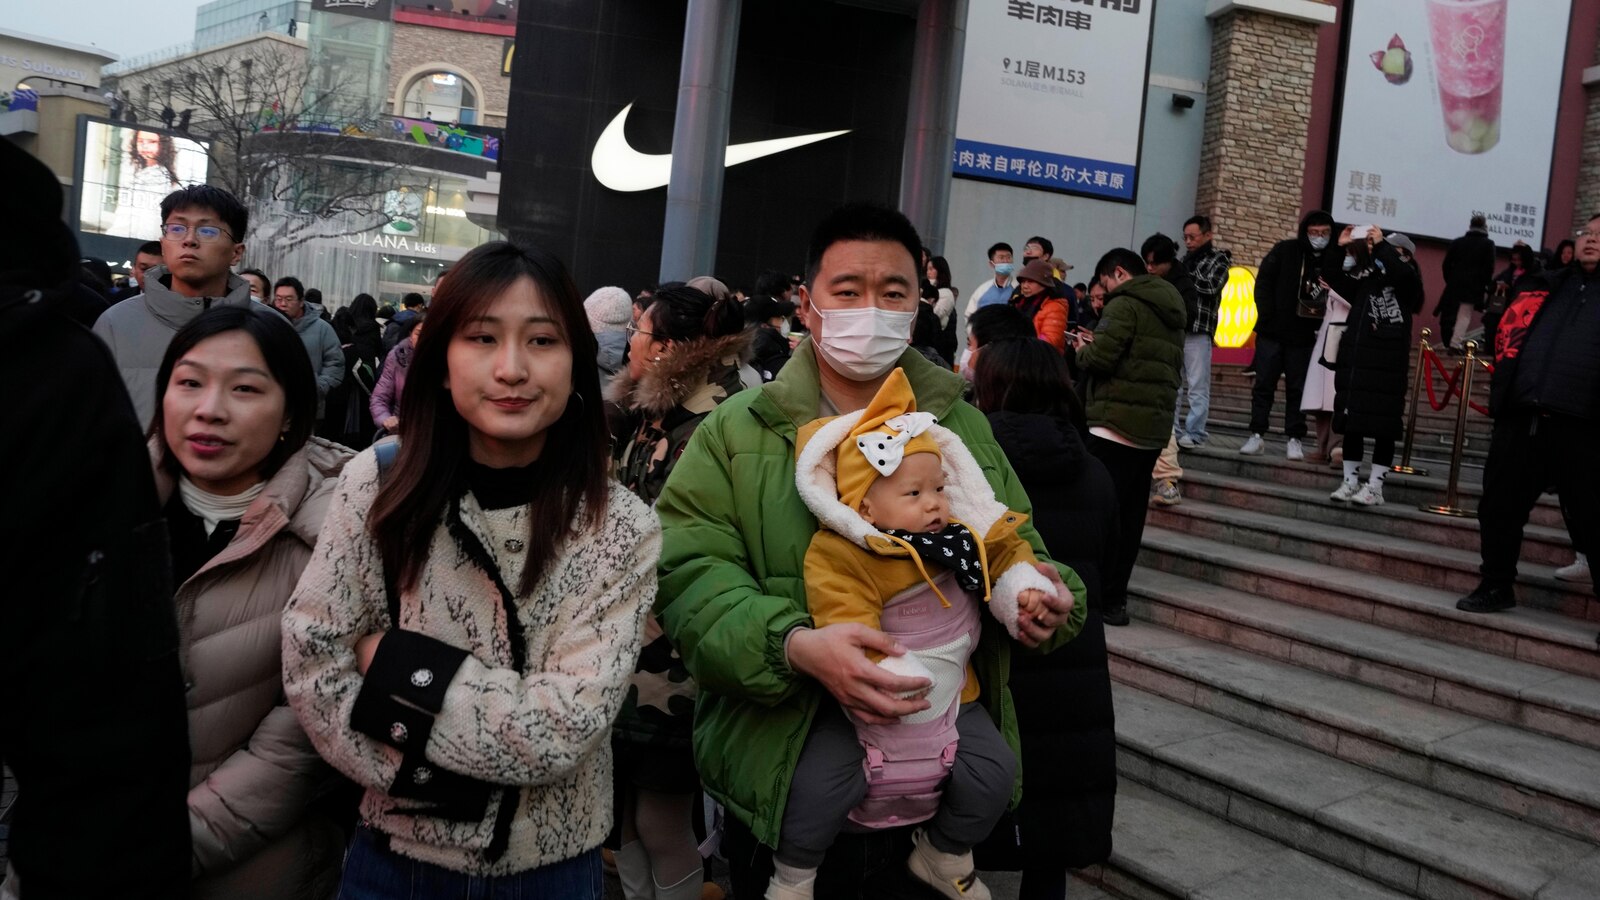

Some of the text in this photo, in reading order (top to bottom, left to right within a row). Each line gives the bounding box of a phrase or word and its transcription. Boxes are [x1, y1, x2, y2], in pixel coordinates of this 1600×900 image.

[1007, 0, 1092, 30] 羊肉串
[22, 57, 87, 80] Subway
[1348, 170, 1382, 192] 真果
[1346, 192, 1398, 218] 无香精
[339, 229, 437, 254] SOLANA kids
